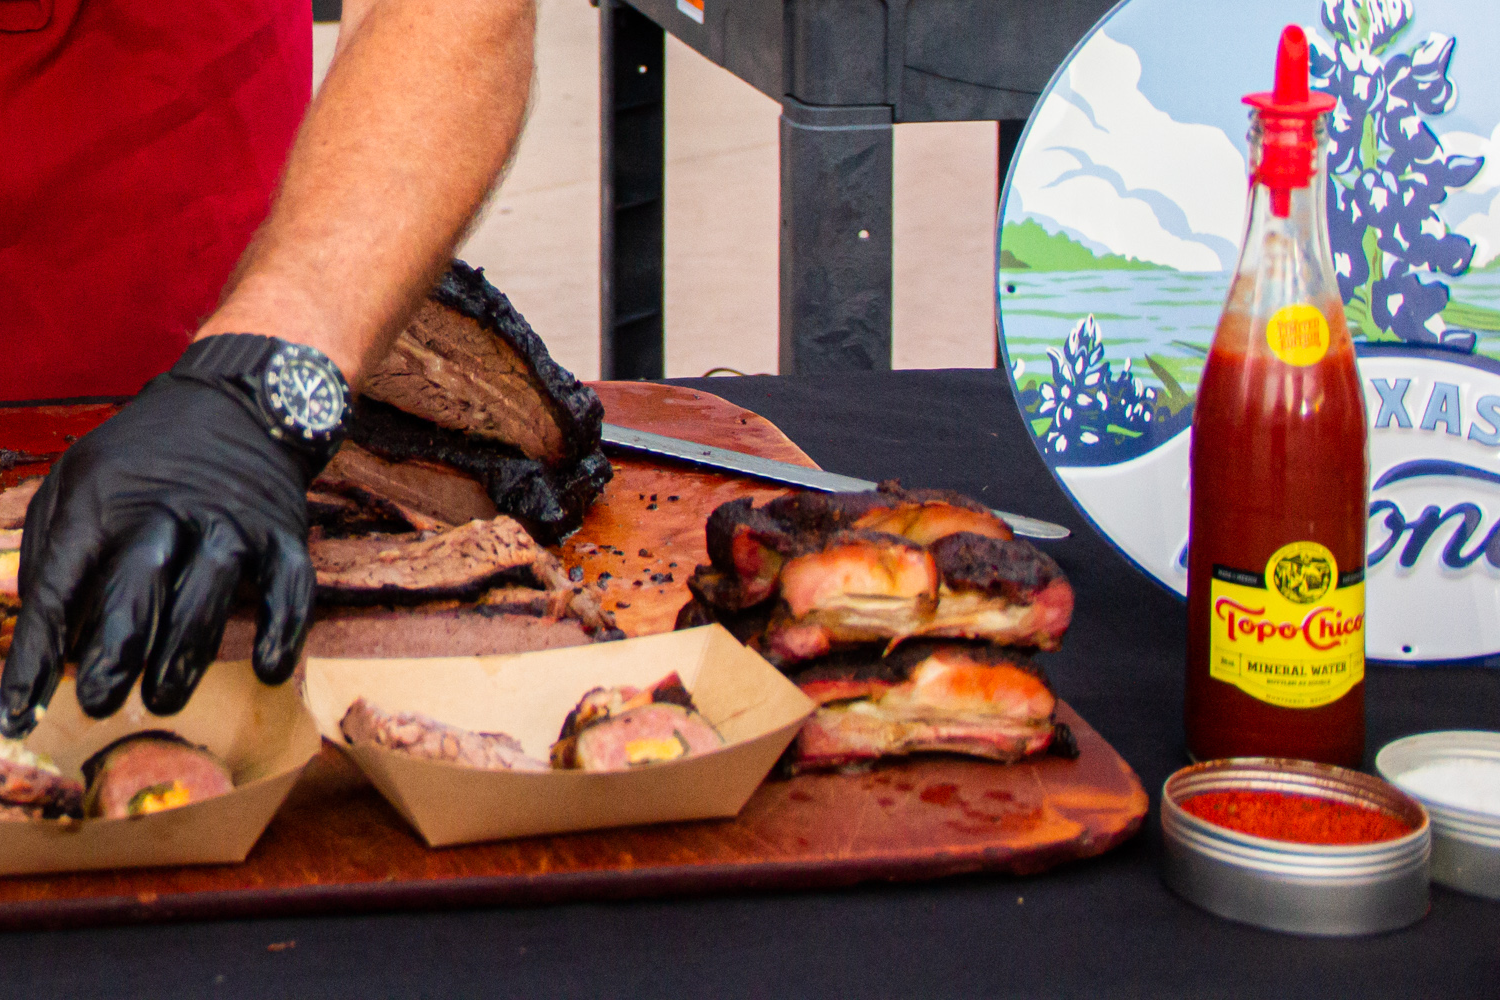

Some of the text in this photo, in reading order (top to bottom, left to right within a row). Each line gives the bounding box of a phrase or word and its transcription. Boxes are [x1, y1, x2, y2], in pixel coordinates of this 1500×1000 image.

[1215, 595, 1365, 650] Topo Chico
[1247, 661, 1308, 676] MINERAL
[1311, 660, 1347, 676] WATER
